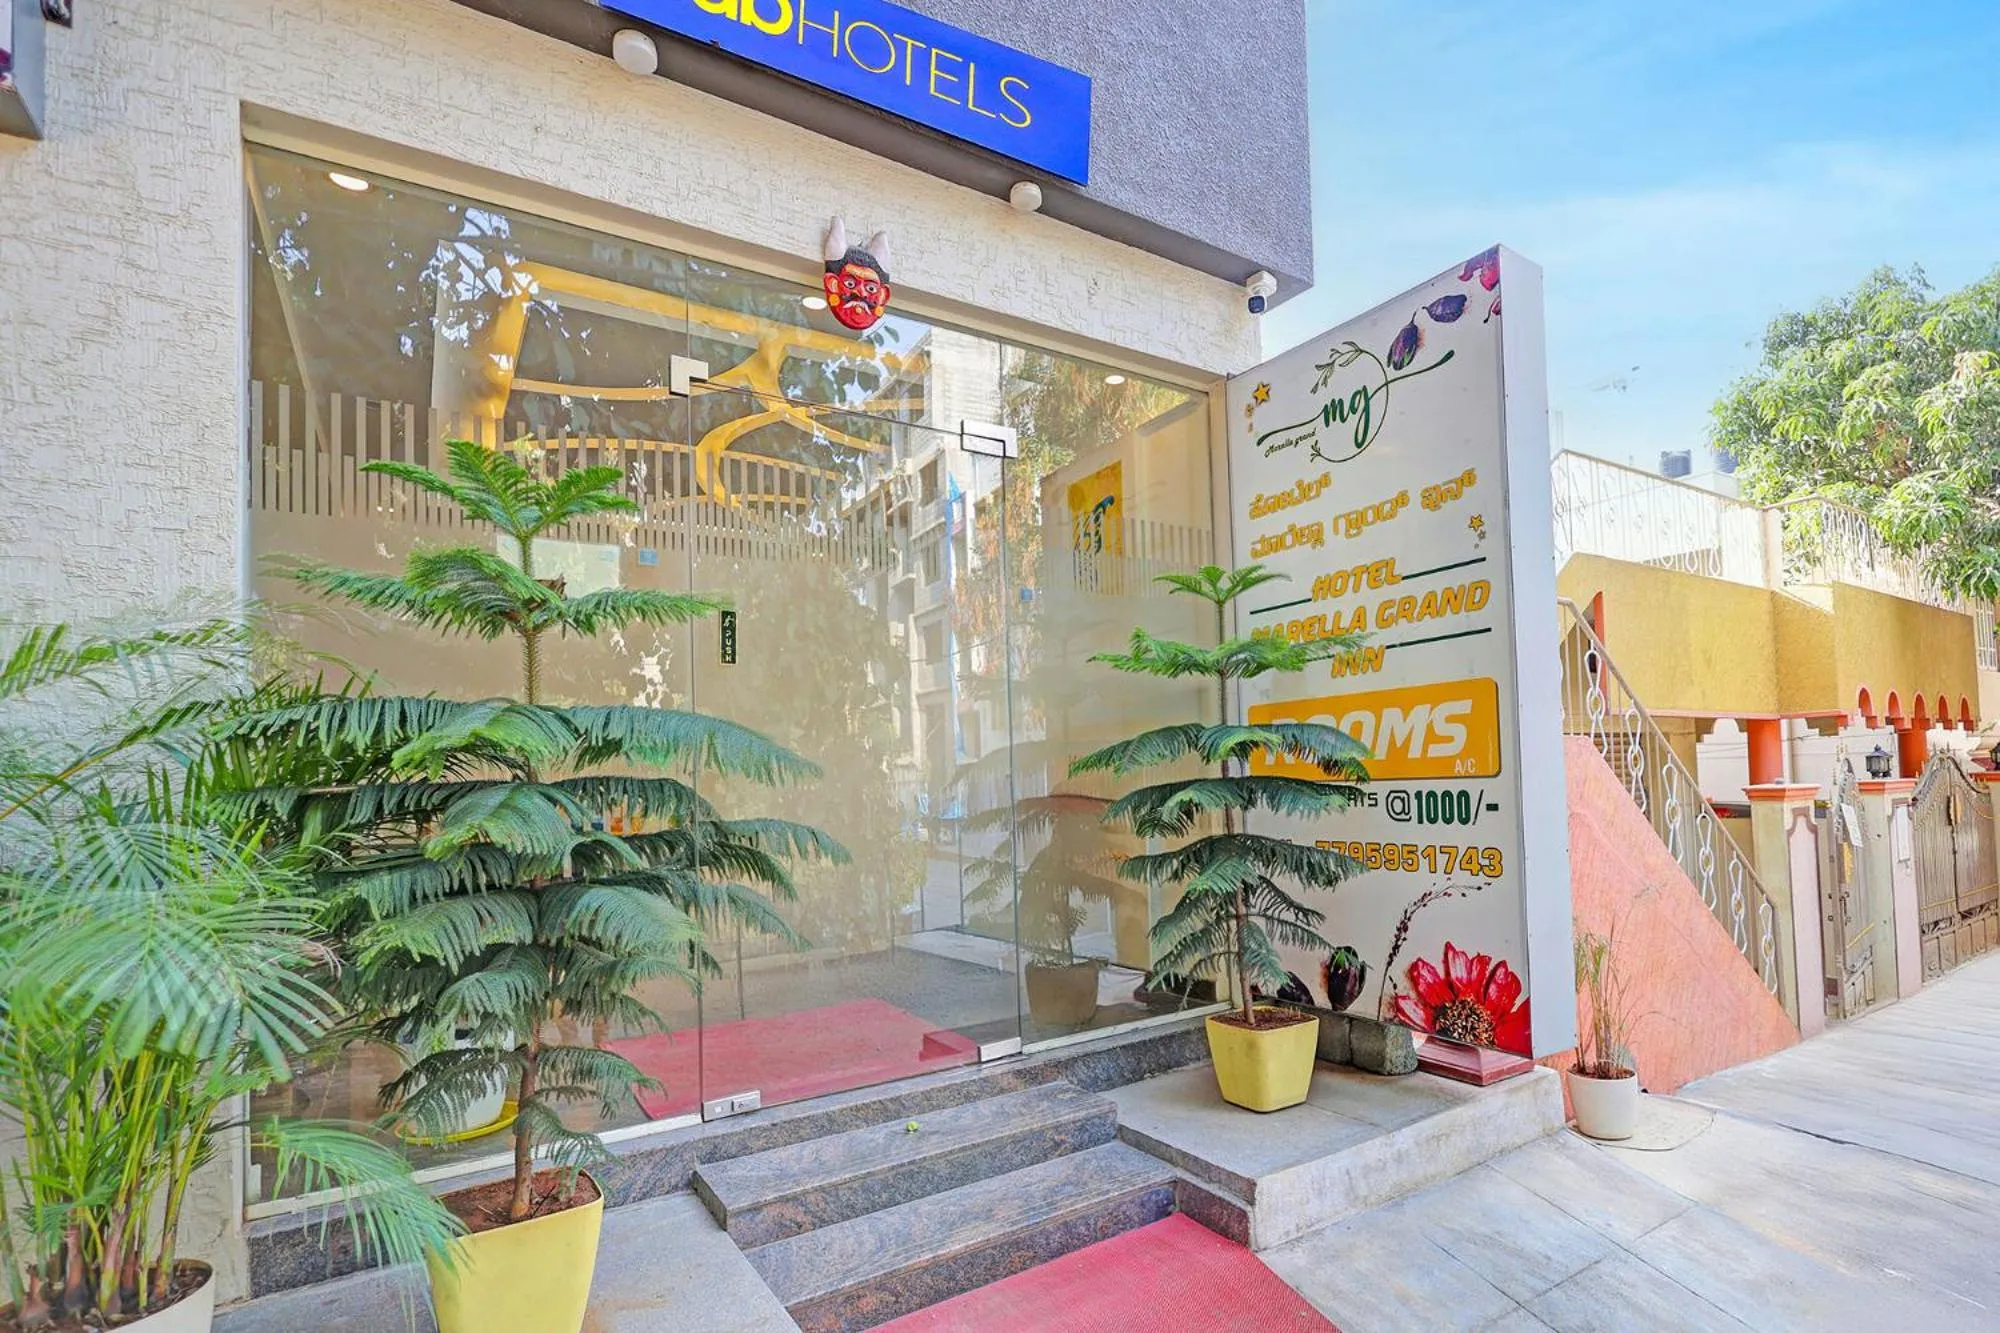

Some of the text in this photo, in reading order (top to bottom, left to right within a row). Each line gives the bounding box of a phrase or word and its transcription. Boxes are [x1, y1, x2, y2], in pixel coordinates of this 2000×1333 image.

[1420, 467, 1478, 512] ಇನ್
[1311, 557, 1402, 602] HOTEL
[1250, 579, 1491, 643] MARELLA GRAND
[1331, 644, 1386, 679] INN
[1454, 758, 1476, 776] A/C
[1385, 789, 1499, 826] @1000/-
